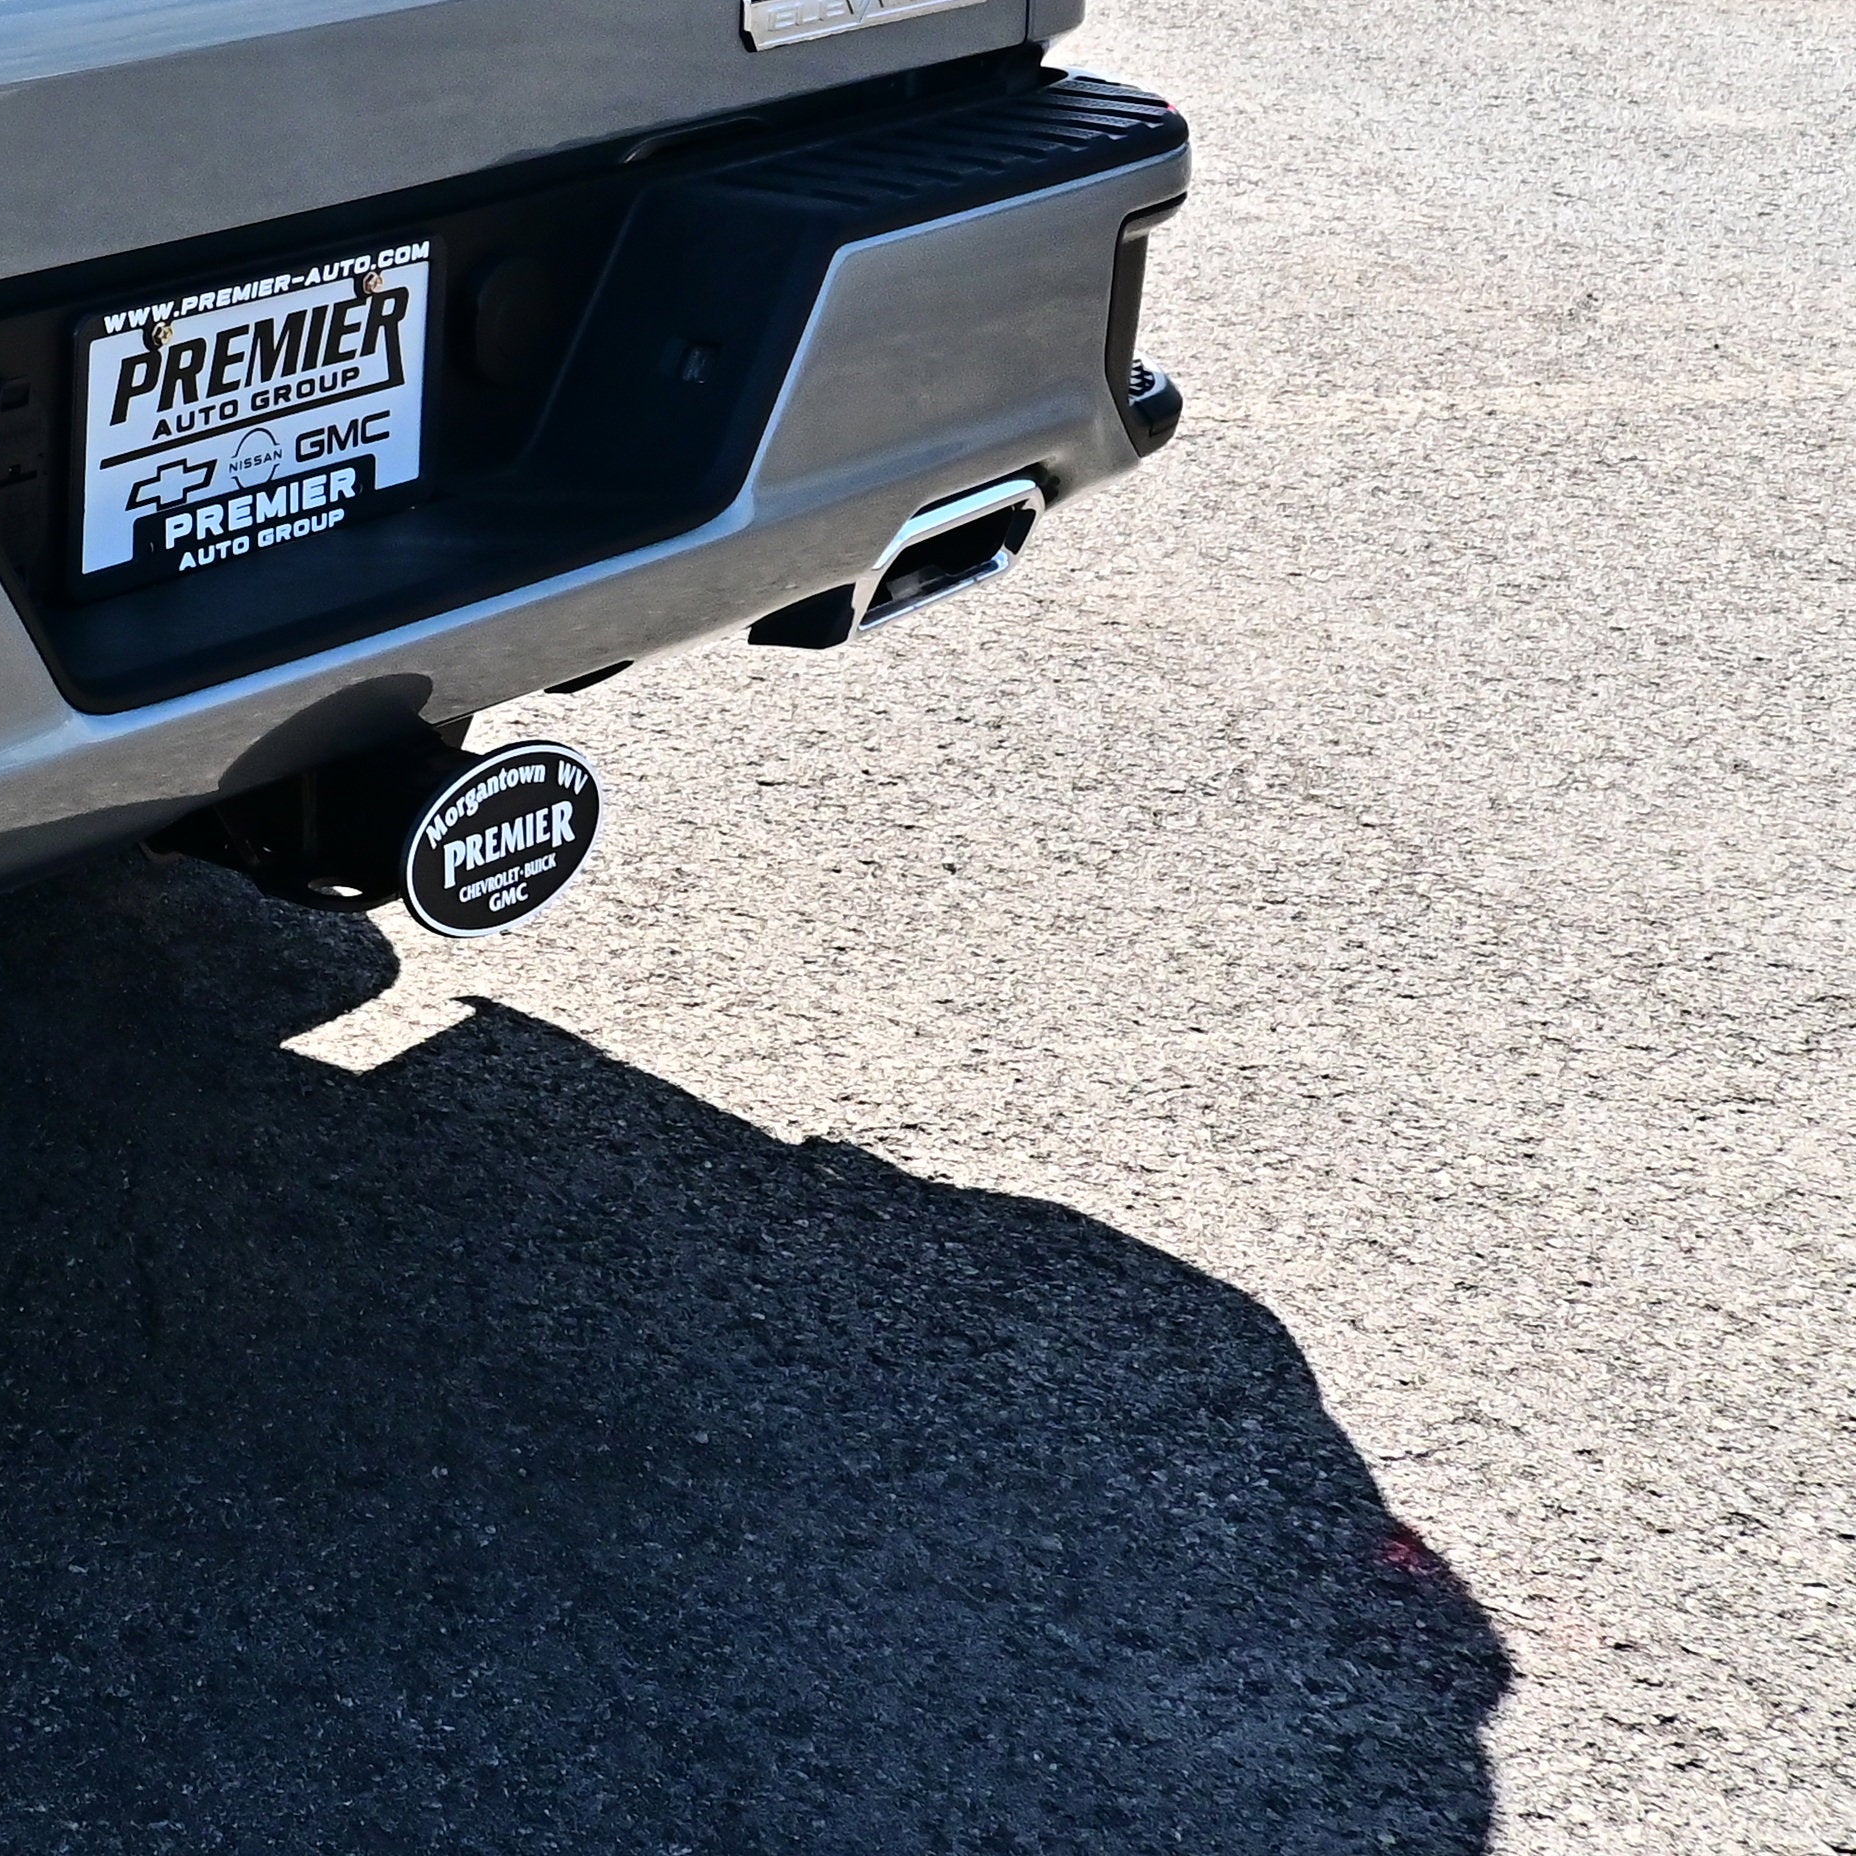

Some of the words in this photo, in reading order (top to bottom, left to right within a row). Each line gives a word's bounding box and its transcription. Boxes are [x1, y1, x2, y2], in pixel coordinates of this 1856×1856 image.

[103, 240, 431, 334] WWW.PREMIER-AUTO.COM
[109, 285, 409, 426] PREMIER
[151, 403, 239, 440] AUTO
[250, 366, 361, 410] GROUP
[228, 447, 283, 474] NISSAN
[295, 410, 391, 463] GMC
[164, 467, 357, 550] PREMIER
[179, 540, 250, 571] AUTO
[257, 508, 345, 547] GROUP
[425, 764, 546, 849] Morgantown
[557, 759, 588, 796] WV
[443, 800, 576, 889] PREMIER
[488, 882, 529, 912] GMC
